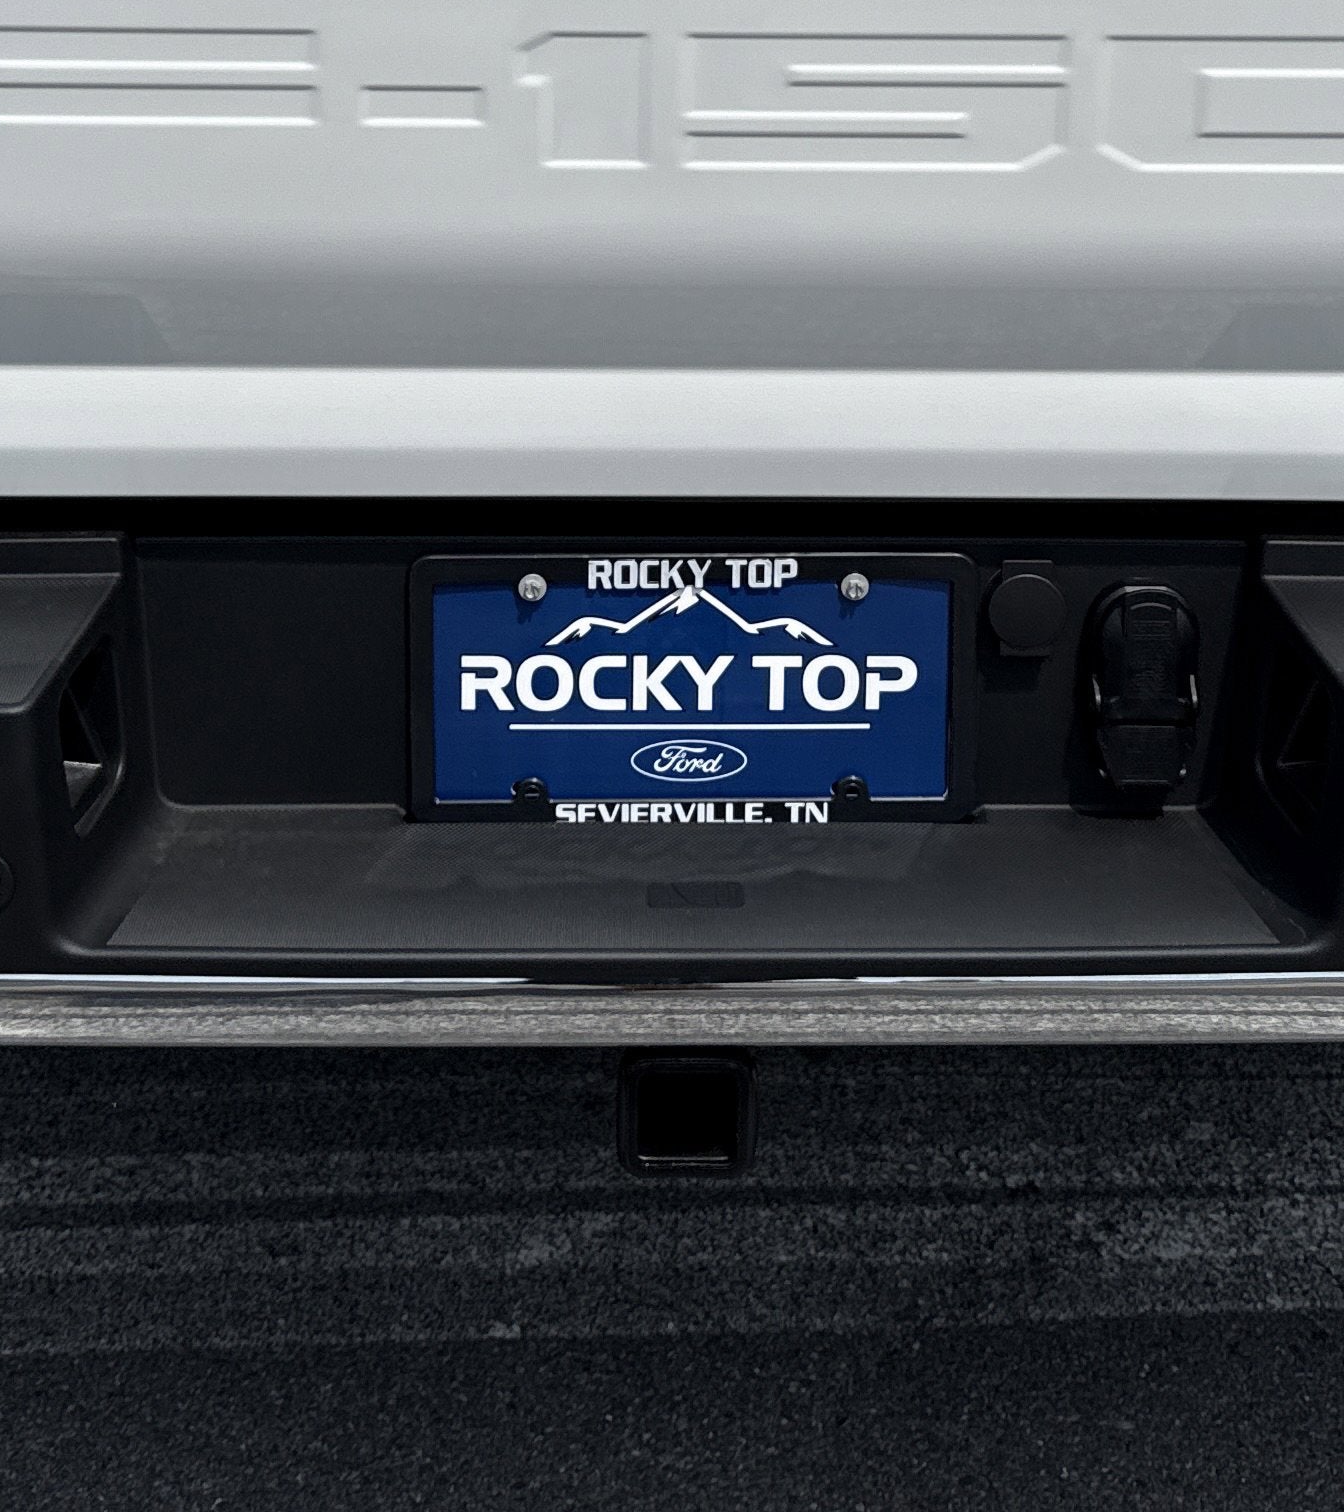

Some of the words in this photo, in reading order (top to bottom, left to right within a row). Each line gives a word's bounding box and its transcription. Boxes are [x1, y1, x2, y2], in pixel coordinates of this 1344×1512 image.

[587, 559, 712, 590] ROCKY
[725, 557, 799, 589] TOP
[459, 654, 736, 712] ROCKY
[751, 654, 919, 711] TOP
[653, 745, 723, 775] Ford
[784, 802, 829, 823] TN
